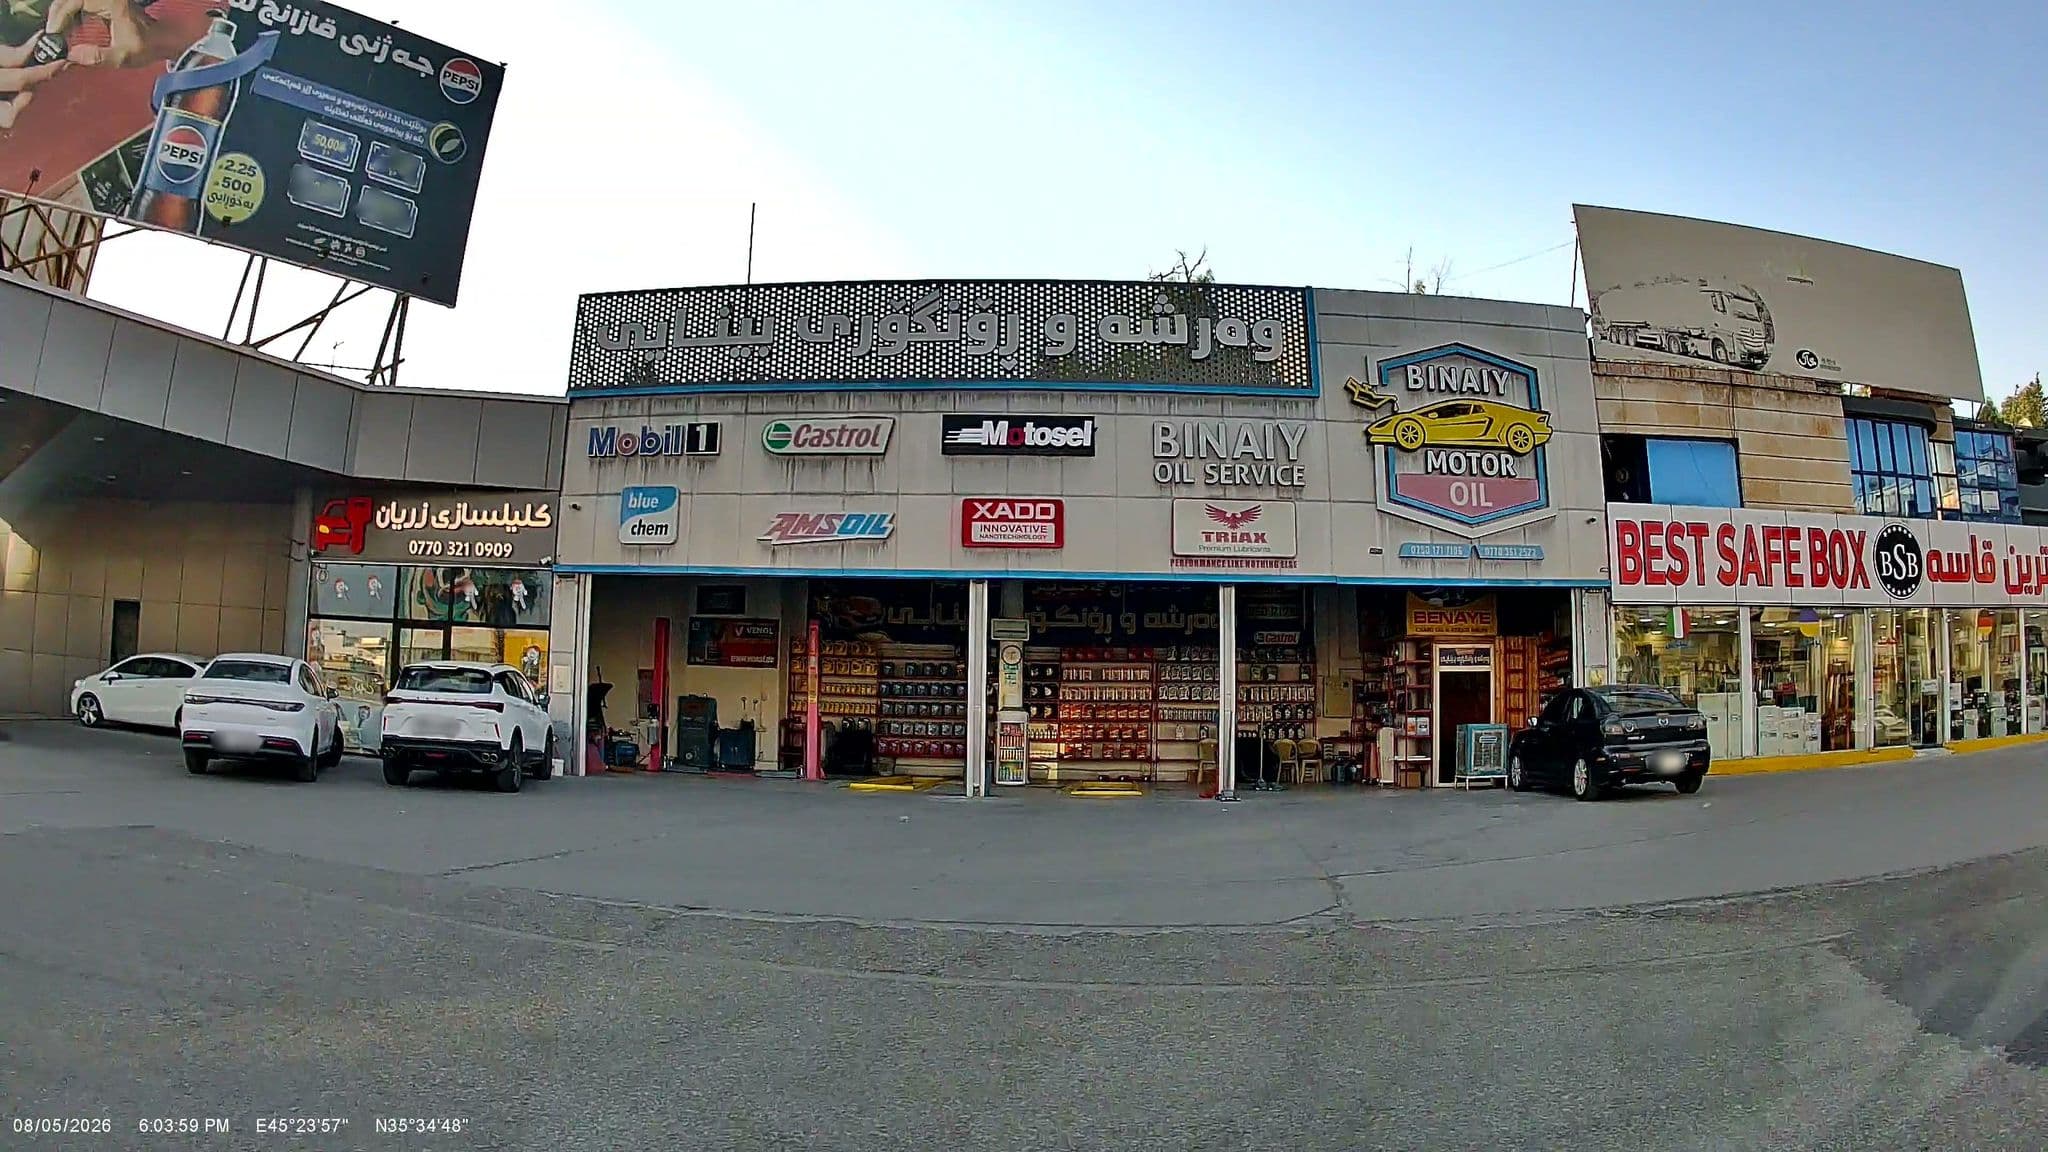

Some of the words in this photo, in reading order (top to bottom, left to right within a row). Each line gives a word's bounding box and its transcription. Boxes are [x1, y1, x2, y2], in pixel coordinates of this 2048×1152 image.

[443, 71, 479, 92] PEPSI
[161, 142, 204, 164] PEPSI
[224, 159, 257, 178] 2.25
[221, 176, 252, 195] 500
[1044, 313, 1077, 356] و
[1406, 364, 1511, 395] BINAIY
[587, 425, 686, 457] Mobil
[793, 423, 881, 449] Castrol
[980, 420, 1093, 447] Motosel
[1152, 421, 1307, 460] BINAIY
[1154, 462, 1195, 484] OIL
[1204, 463, 1306, 486] SERVICE
[1426, 451, 1517, 476] MOTOR
[628, 493, 660, 510] blue
[1449, 481, 1493, 507] OIL
[376, 501, 429, 531] زریان
[430, 501, 551, 533] کلیلسازی
[972, 502, 1056, 520] XADO
[630, 516, 669, 536] chem
[764, 513, 894, 540] AMSOIL
[979, 524, 1048, 534] INNOVATIVE
[409, 540, 442, 556] 0770
[447, 541, 470, 556] 321
[475, 542, 513, 558] 0909
[1616, 519, 1709, 586] BEST
[1716, 522, 1804, 589] SAFE
[1807, 527, 1871, 590] BOX
[1880, 543, 1919, 580] BSB
[1170, 558, 1226, 569] PERFORMANCE
[1227, 559, 1244, 568] LIKE
[1245, 559, 1279, 569] NOTHING
[1280, 560, 1298, 569] ELSE
[1413, 610, 1491, 625] BENAYE
